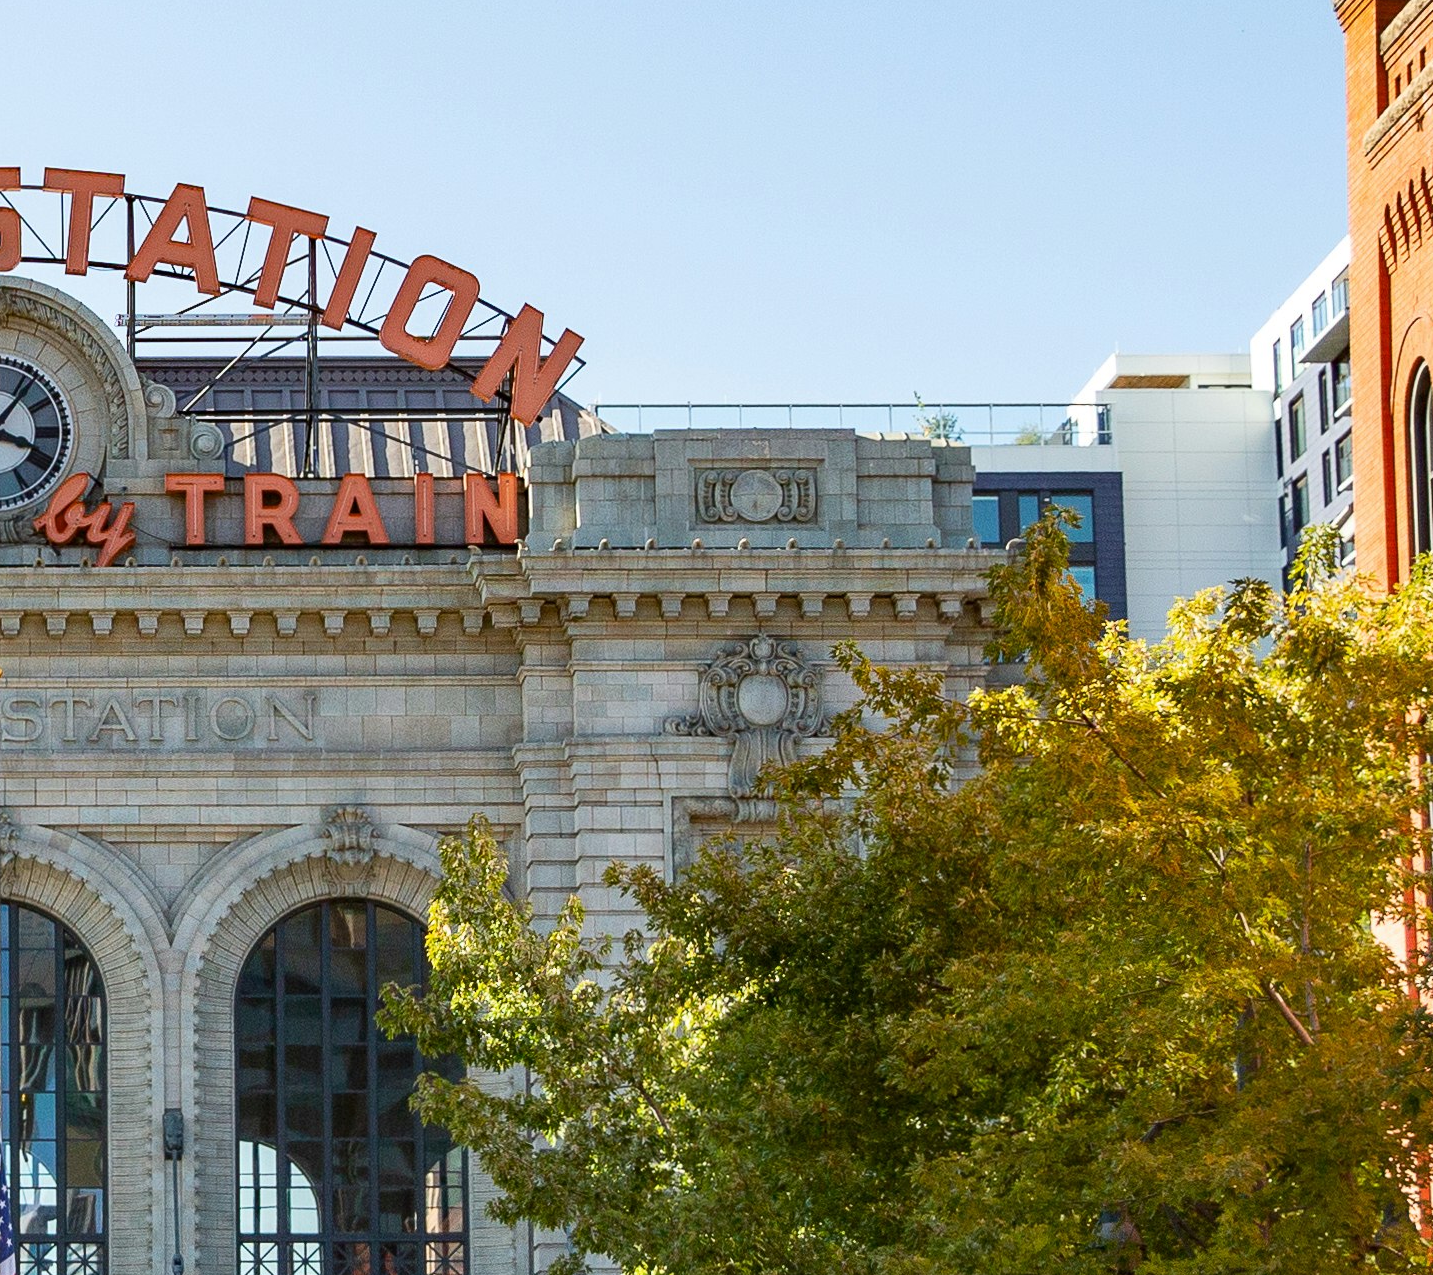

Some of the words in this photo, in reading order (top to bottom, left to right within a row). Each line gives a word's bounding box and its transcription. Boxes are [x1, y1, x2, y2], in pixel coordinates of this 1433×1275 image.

[33, 472, 136, 567] by
[164, 472, 518, 546] TRAIN
[0, 694, 316, 742] STATION
